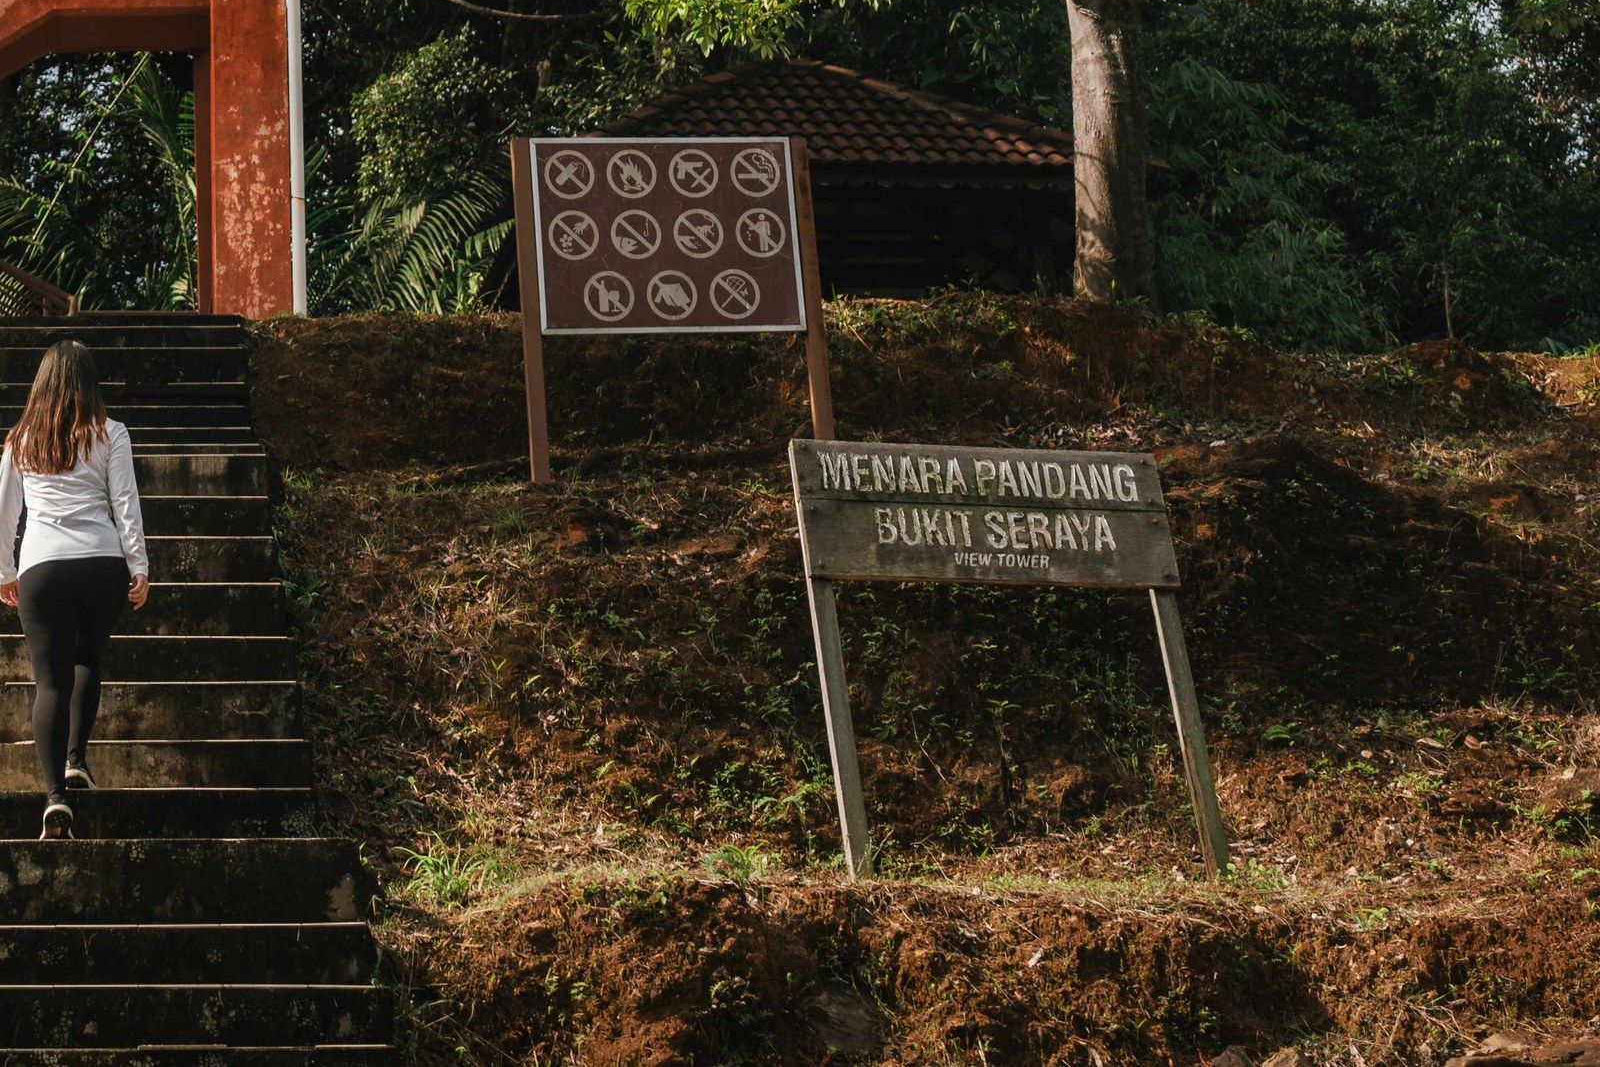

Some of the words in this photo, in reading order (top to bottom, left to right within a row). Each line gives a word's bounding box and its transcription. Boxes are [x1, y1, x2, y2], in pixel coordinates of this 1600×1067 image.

[817, 451, 967, 494] MENARA
[973, 458, 1138, 501] PANDANG
[874, 508, 973, 547] BUKIT
[984, 510, 1117, 551] SERAYA
[954, 552, 993, 568] VIEW
[997, 553, 1050, 569] TOWER
